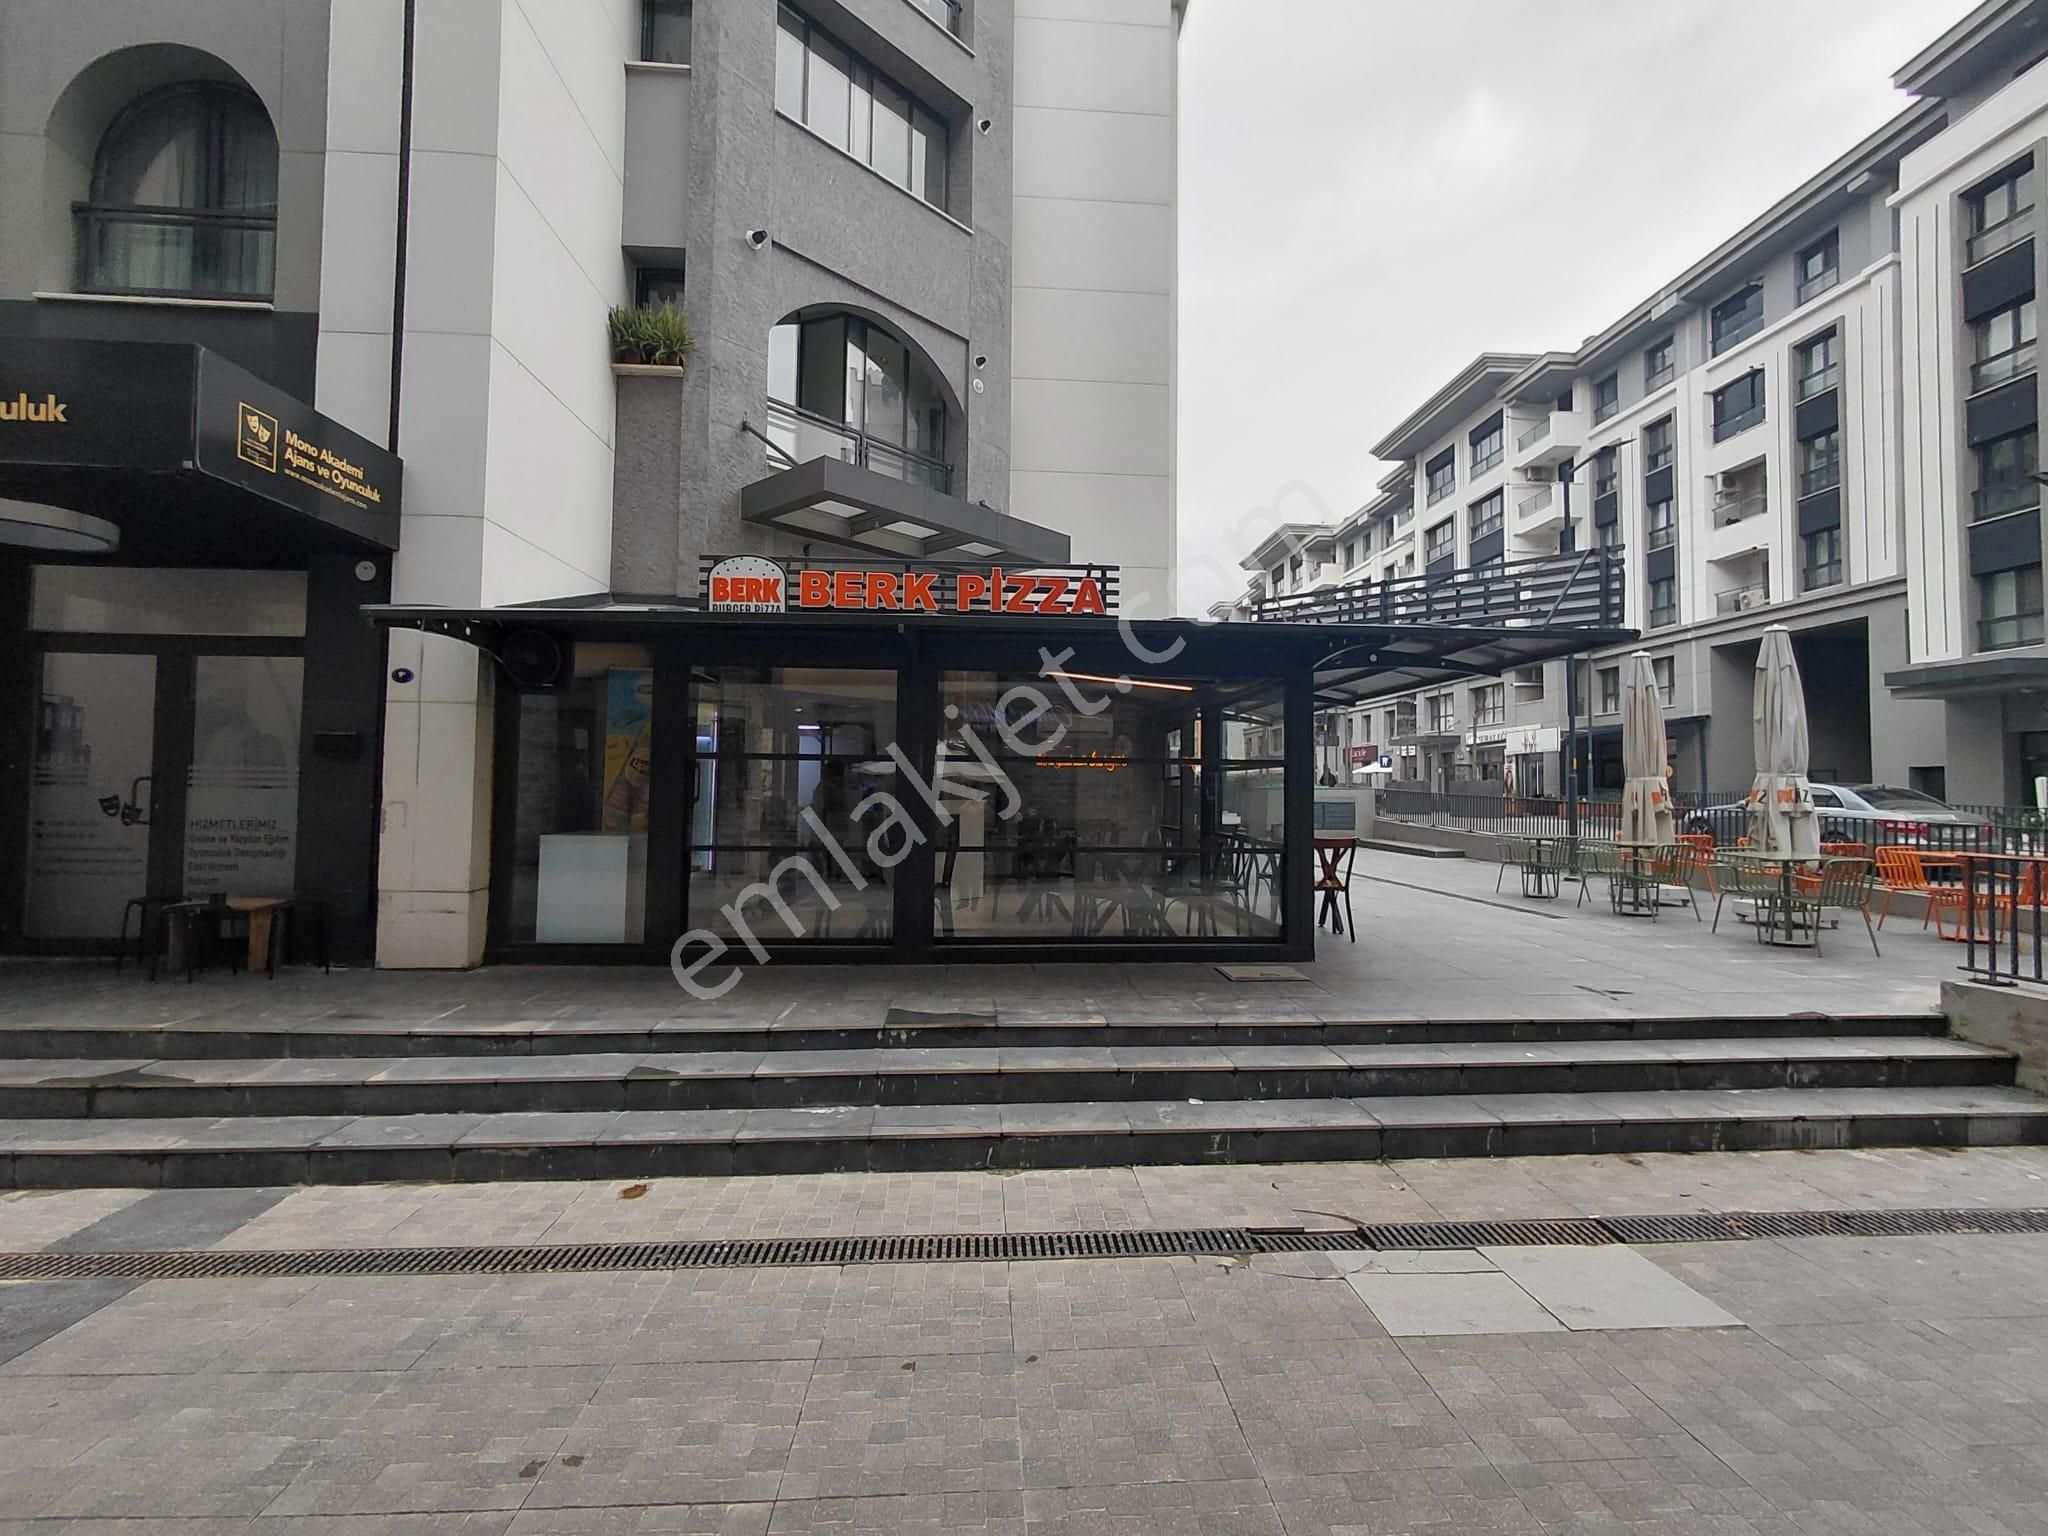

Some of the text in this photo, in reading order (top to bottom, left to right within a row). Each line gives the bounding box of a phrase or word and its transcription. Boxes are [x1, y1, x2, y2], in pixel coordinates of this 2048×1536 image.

[284, 447, 315, 472] Ajans
[317, 465, 330, 479] ve
[331, 469, 381, 503] Oyunculuk
[285, 429, 318, 458] Mono
[319, 448, 364, 481] Akademi
[712, 576, 782, 603] BERK
[712, 603, 751, 612] BURGER
[799, 570, 938, 611] BERK
